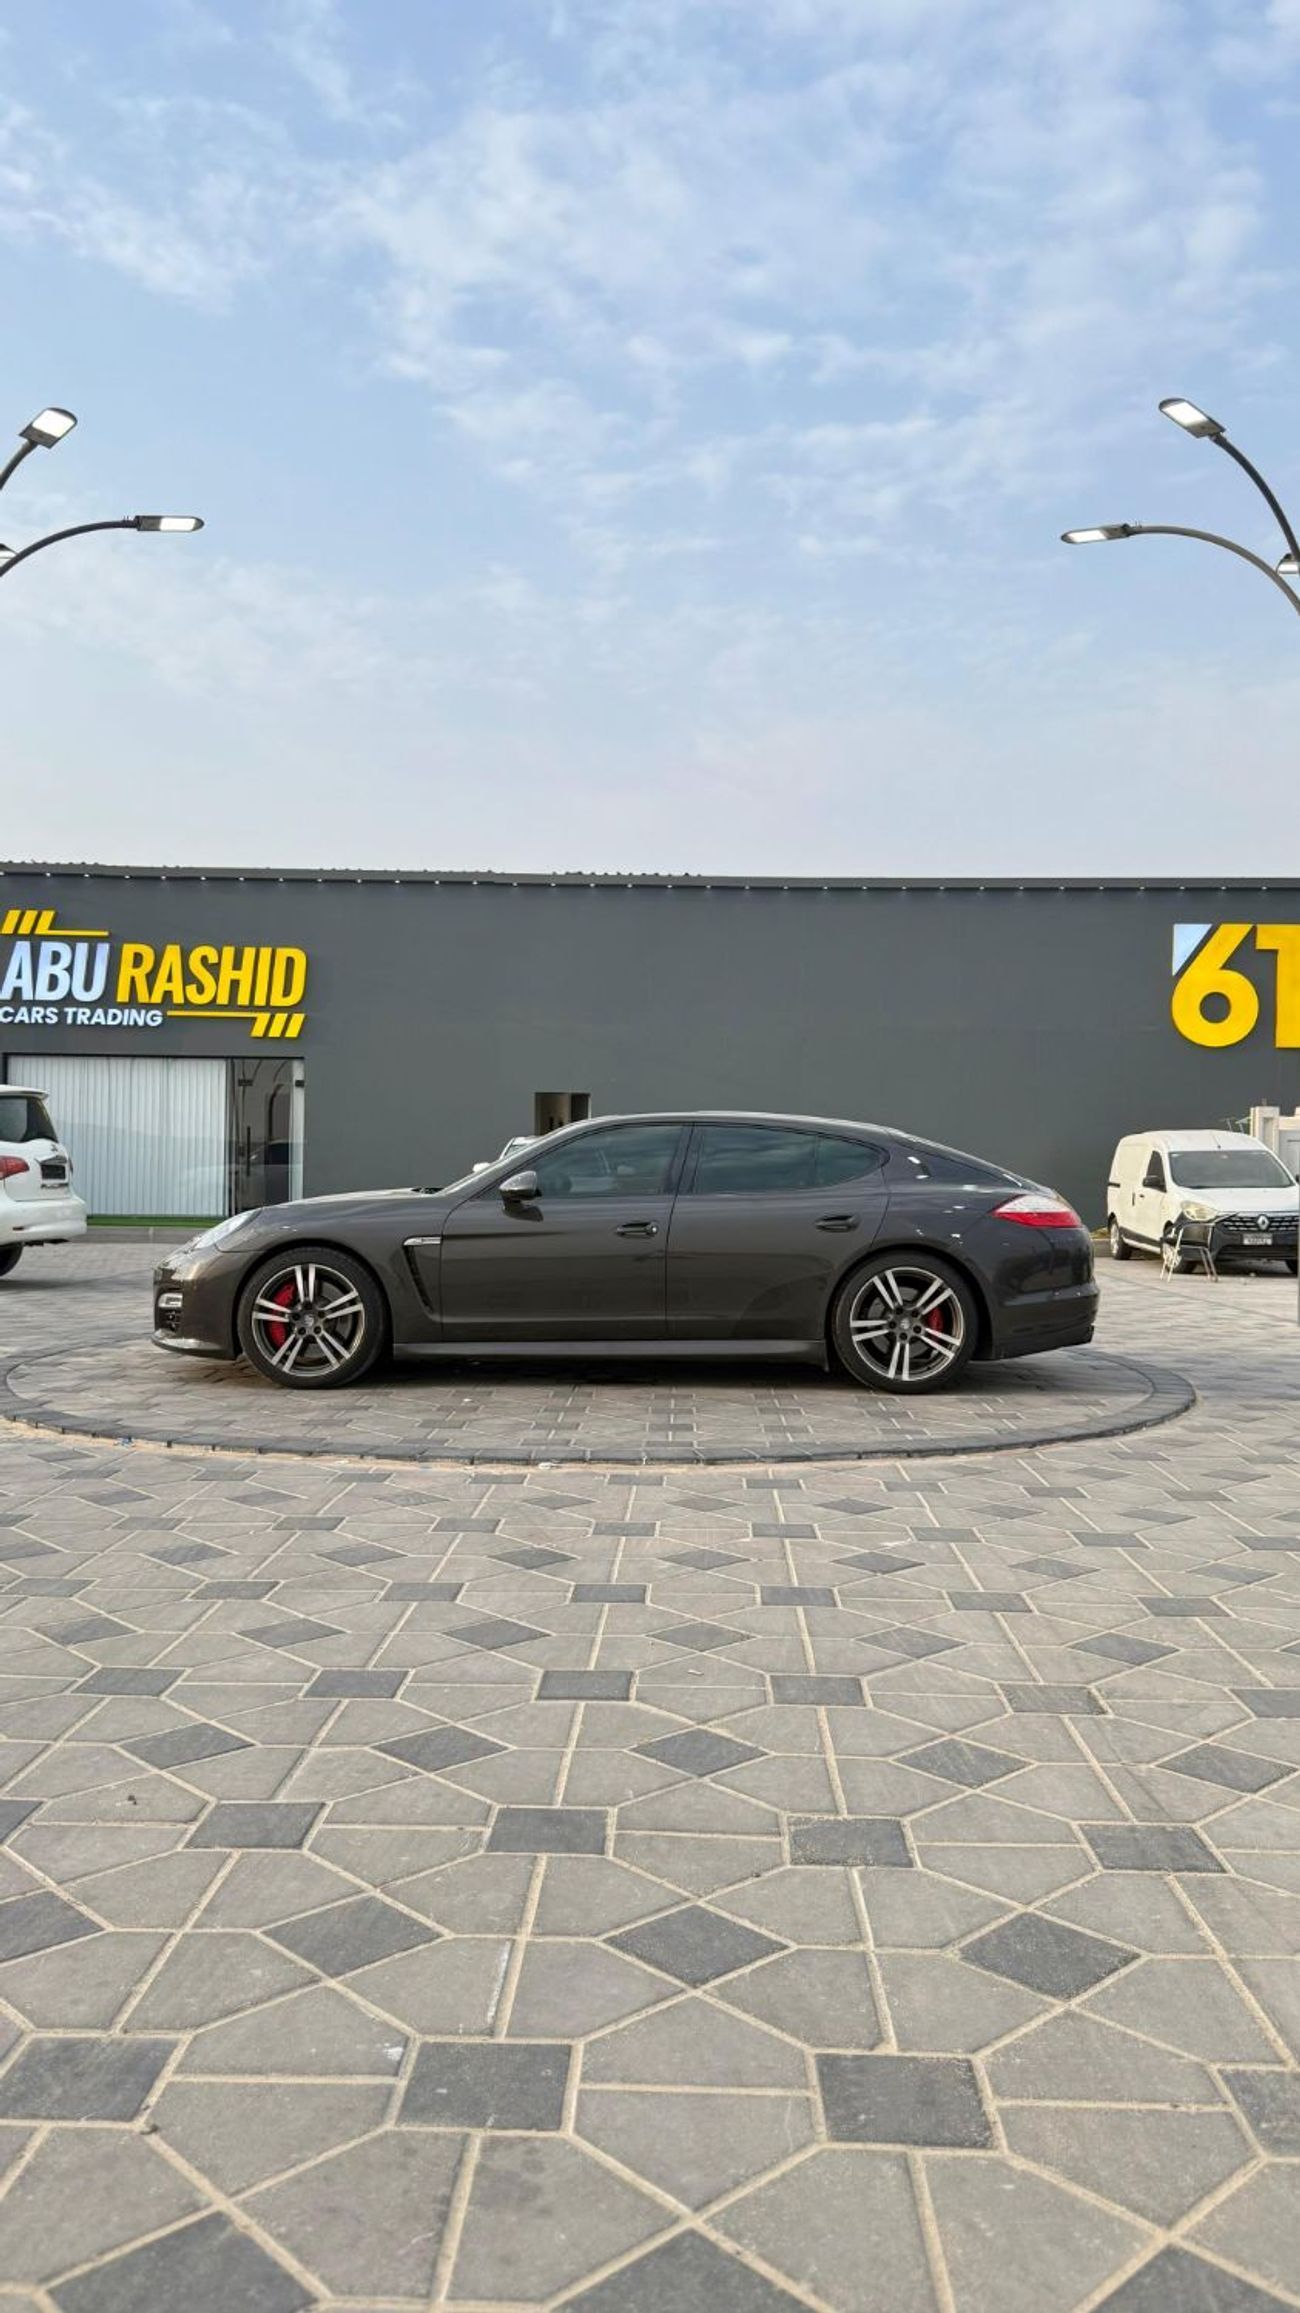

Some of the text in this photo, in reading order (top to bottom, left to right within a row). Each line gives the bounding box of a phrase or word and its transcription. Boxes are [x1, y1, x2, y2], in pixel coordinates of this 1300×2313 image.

[0, 941, 307, 1007] ABU RASHID
[0, 1006, 163, 1026] CARS TRADING
